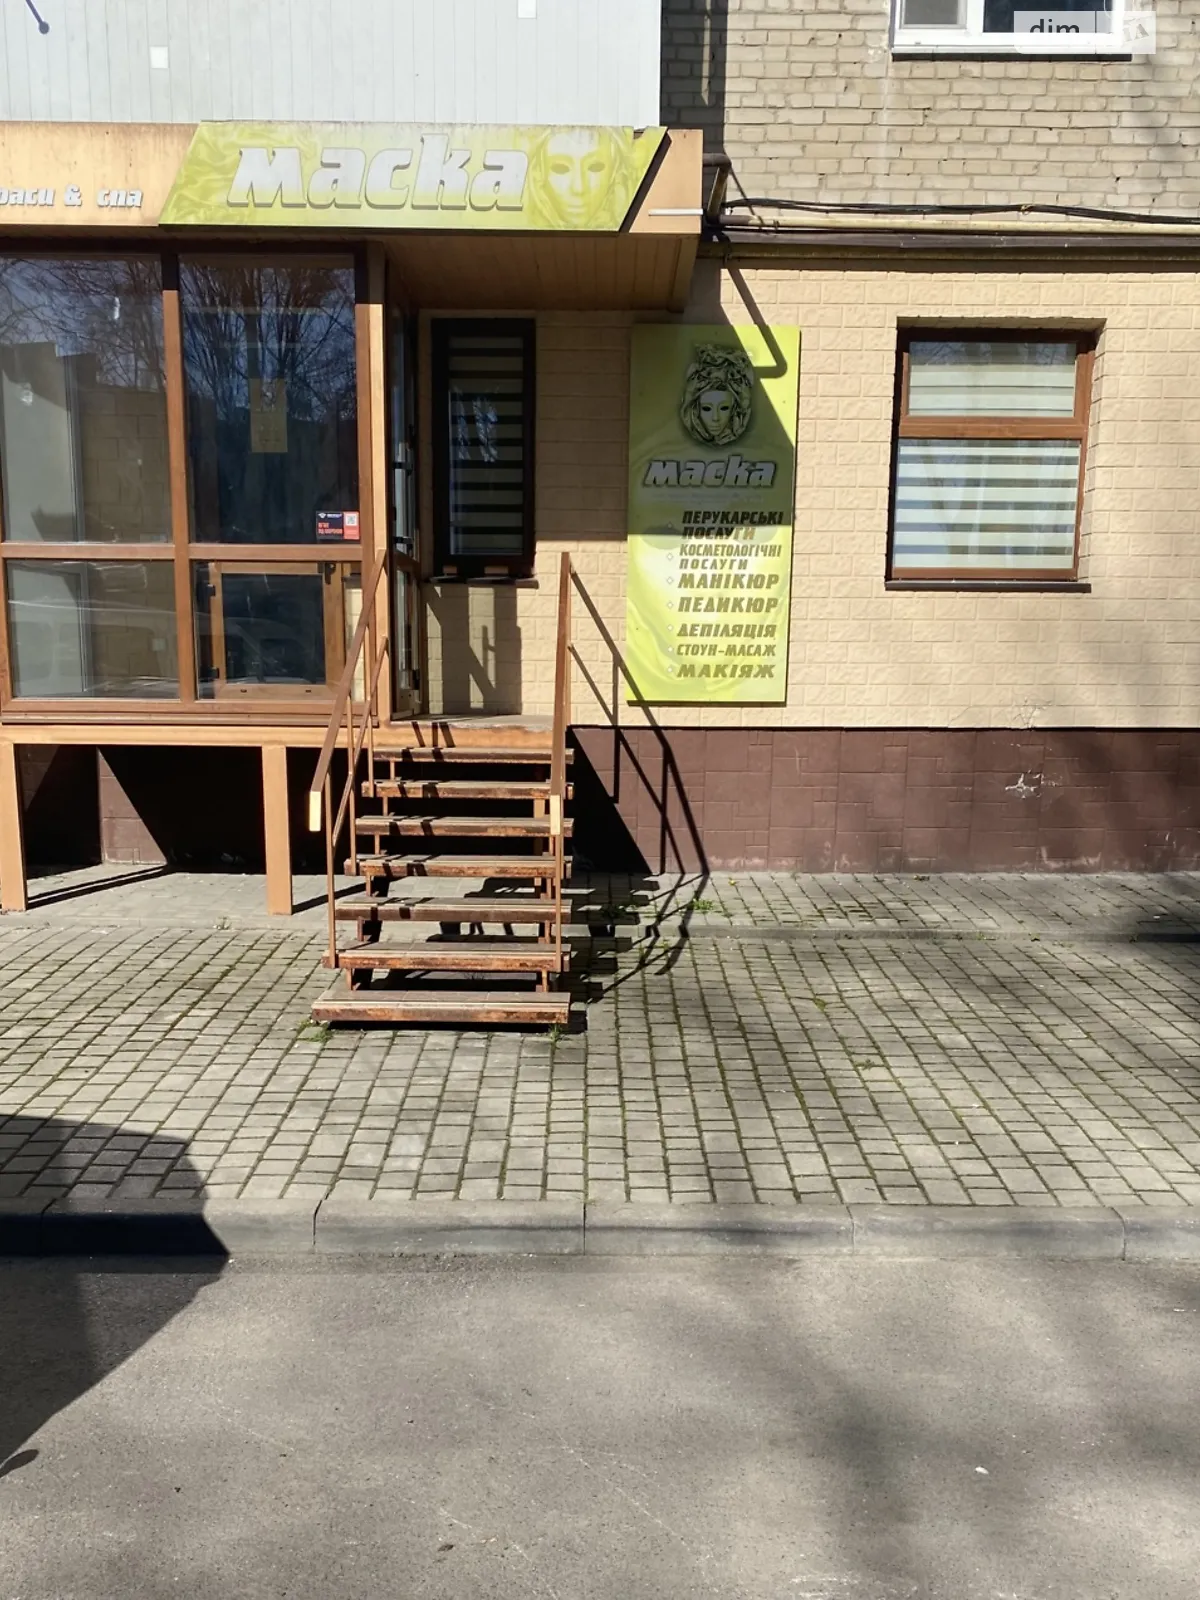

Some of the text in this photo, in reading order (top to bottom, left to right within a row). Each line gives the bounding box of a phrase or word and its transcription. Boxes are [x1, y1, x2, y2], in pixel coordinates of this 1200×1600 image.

[64, 184, 82, 207] &
[682, 511, 784, 525] ПЕРУКАРСЬКІ
[682, 526, 756, 540] ПОСЛУГИ
[680, 544, 782, 557] КОСМЕТОЛОГІЧНІ
[679, 558, 748, 570] ПОСЛУГИ
[678, 573, 779, 589] МАНІКЮР
[678, 596, 778, 613] ПЕДИКЮР
[677, 623, 777, 639] ДЕПІЛЯЦІЯ
[676, 643, 776, 657] СТОУН-МАСАЖ
[677, 663, 776, 678] МАКІЯЖ
